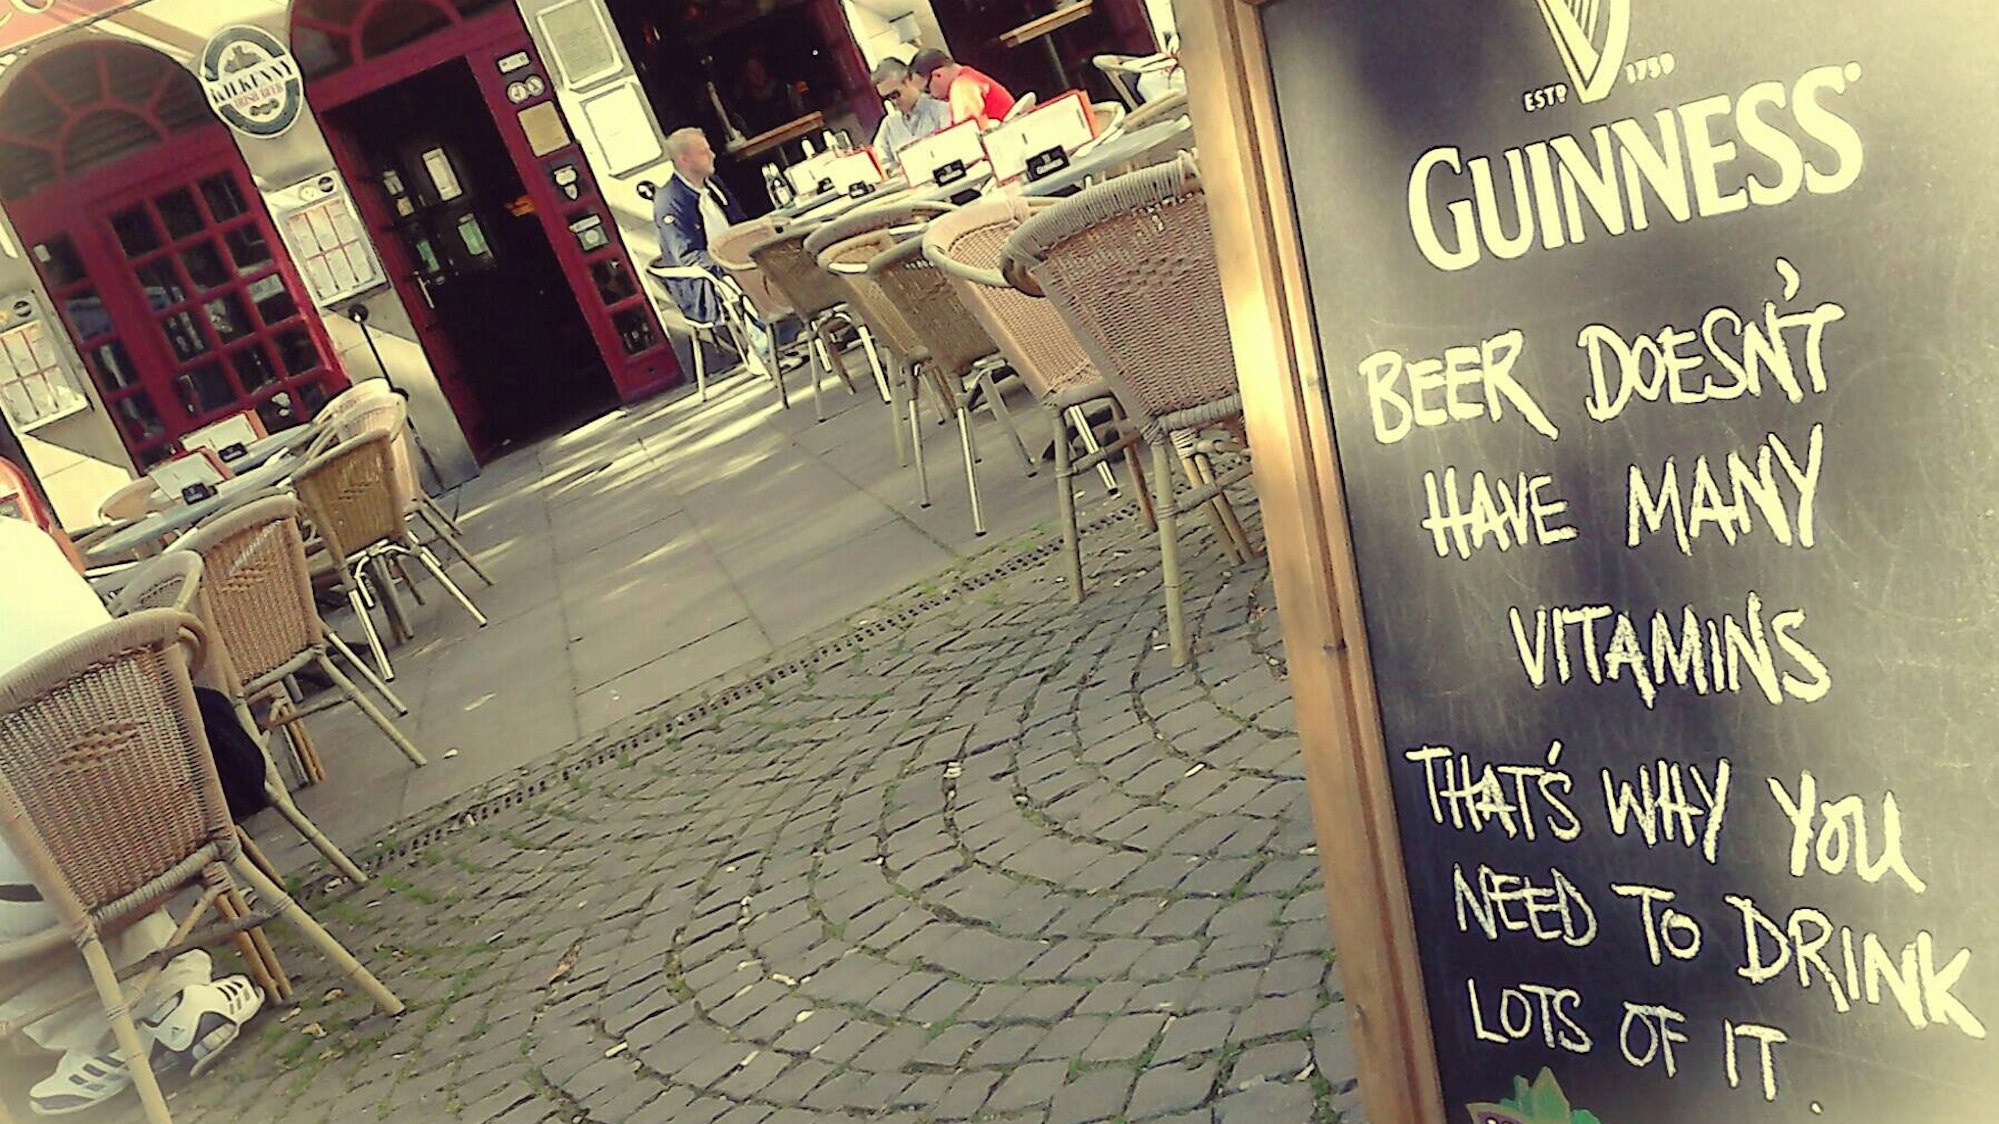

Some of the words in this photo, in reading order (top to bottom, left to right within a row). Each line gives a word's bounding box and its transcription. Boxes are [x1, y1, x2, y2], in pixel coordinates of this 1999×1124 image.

[1625, 52, 1676, 84] 1759
[1407, 63, 1864, 271] GUINNESS
[1359, 329, 1559, 444] BEER
[1577, 257, 1846, 422] DOESN'T
[1421, 465, 1580, 560] HAVE
[1626, 422, 1824, 557] MANY
[1509, 589, 1833, 709] VITAMINS
[1404, 740, 1582, 842] THAT'S
[1602, 757, 1731, 865] WHY
[1767, 768, 1928, 895] YOU
[1453, 862, 1598, 948] NEED
[1610, 882, 1702, 967] TO
[1724, 893, 1988, 1041] DRINK
[1467, 977, 1594, 1055] LOTS
[1619, 1000, 1690, 1079] OF
